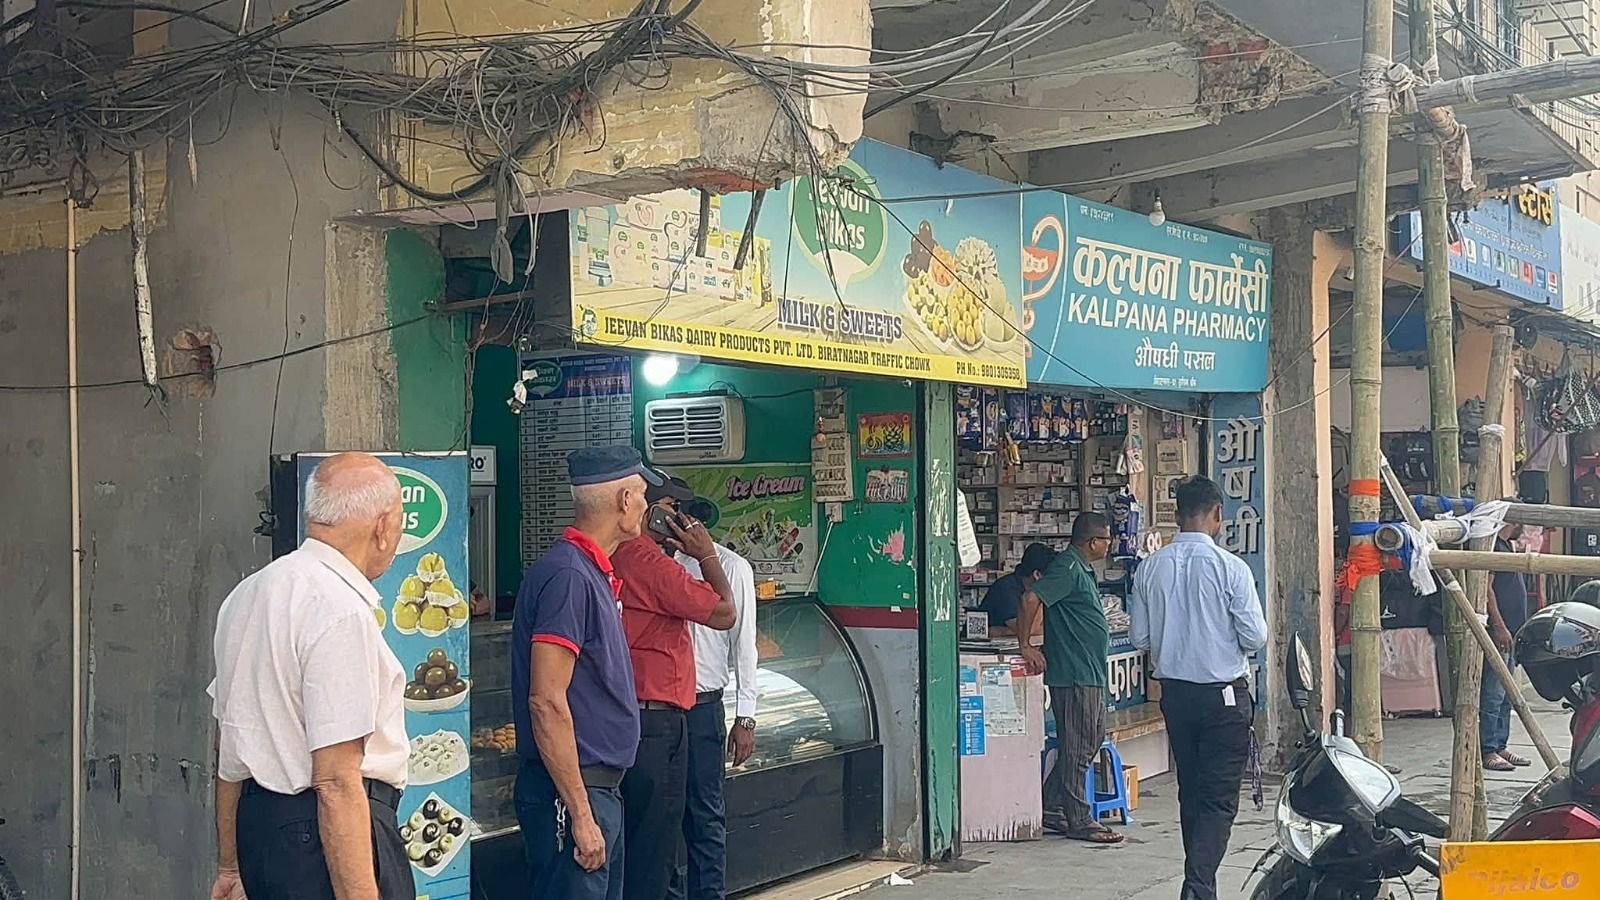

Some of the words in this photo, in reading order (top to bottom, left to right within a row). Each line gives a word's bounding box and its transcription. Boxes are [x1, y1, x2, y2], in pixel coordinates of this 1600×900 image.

[1073, 236, 1182, 300] कल्पना
[777, 297, 820, 328] MILK
[825, 306, 835, 330] &
[841, 308, 902, 339] SWEETS
[1068, 292, 1168, 334] KALPANA
[1173, 308, 1266, 342] PHARMACY
[605, 316, 647, 338] JEEVAN
[650, 323, 683, 343] BIKAS
[686, 328, 717, 347] DAIRY
[719, 332, 771, 353] PRODUCTS
[773, 339, 794, 356] PVT.
[796, 343, 816, 360] LTD.
[817, 345, 869, 365] BIRATNAGAR
[870, 351, 903, 368] TRAFFIC
[904, 355, 931, 371] CHOWK
[1183, 350, 1216, 371] पसल
[956, 361, 966, 375] PH
[726, 476, 751, 499] Ice
[752, 473, 805, 498] Cream
